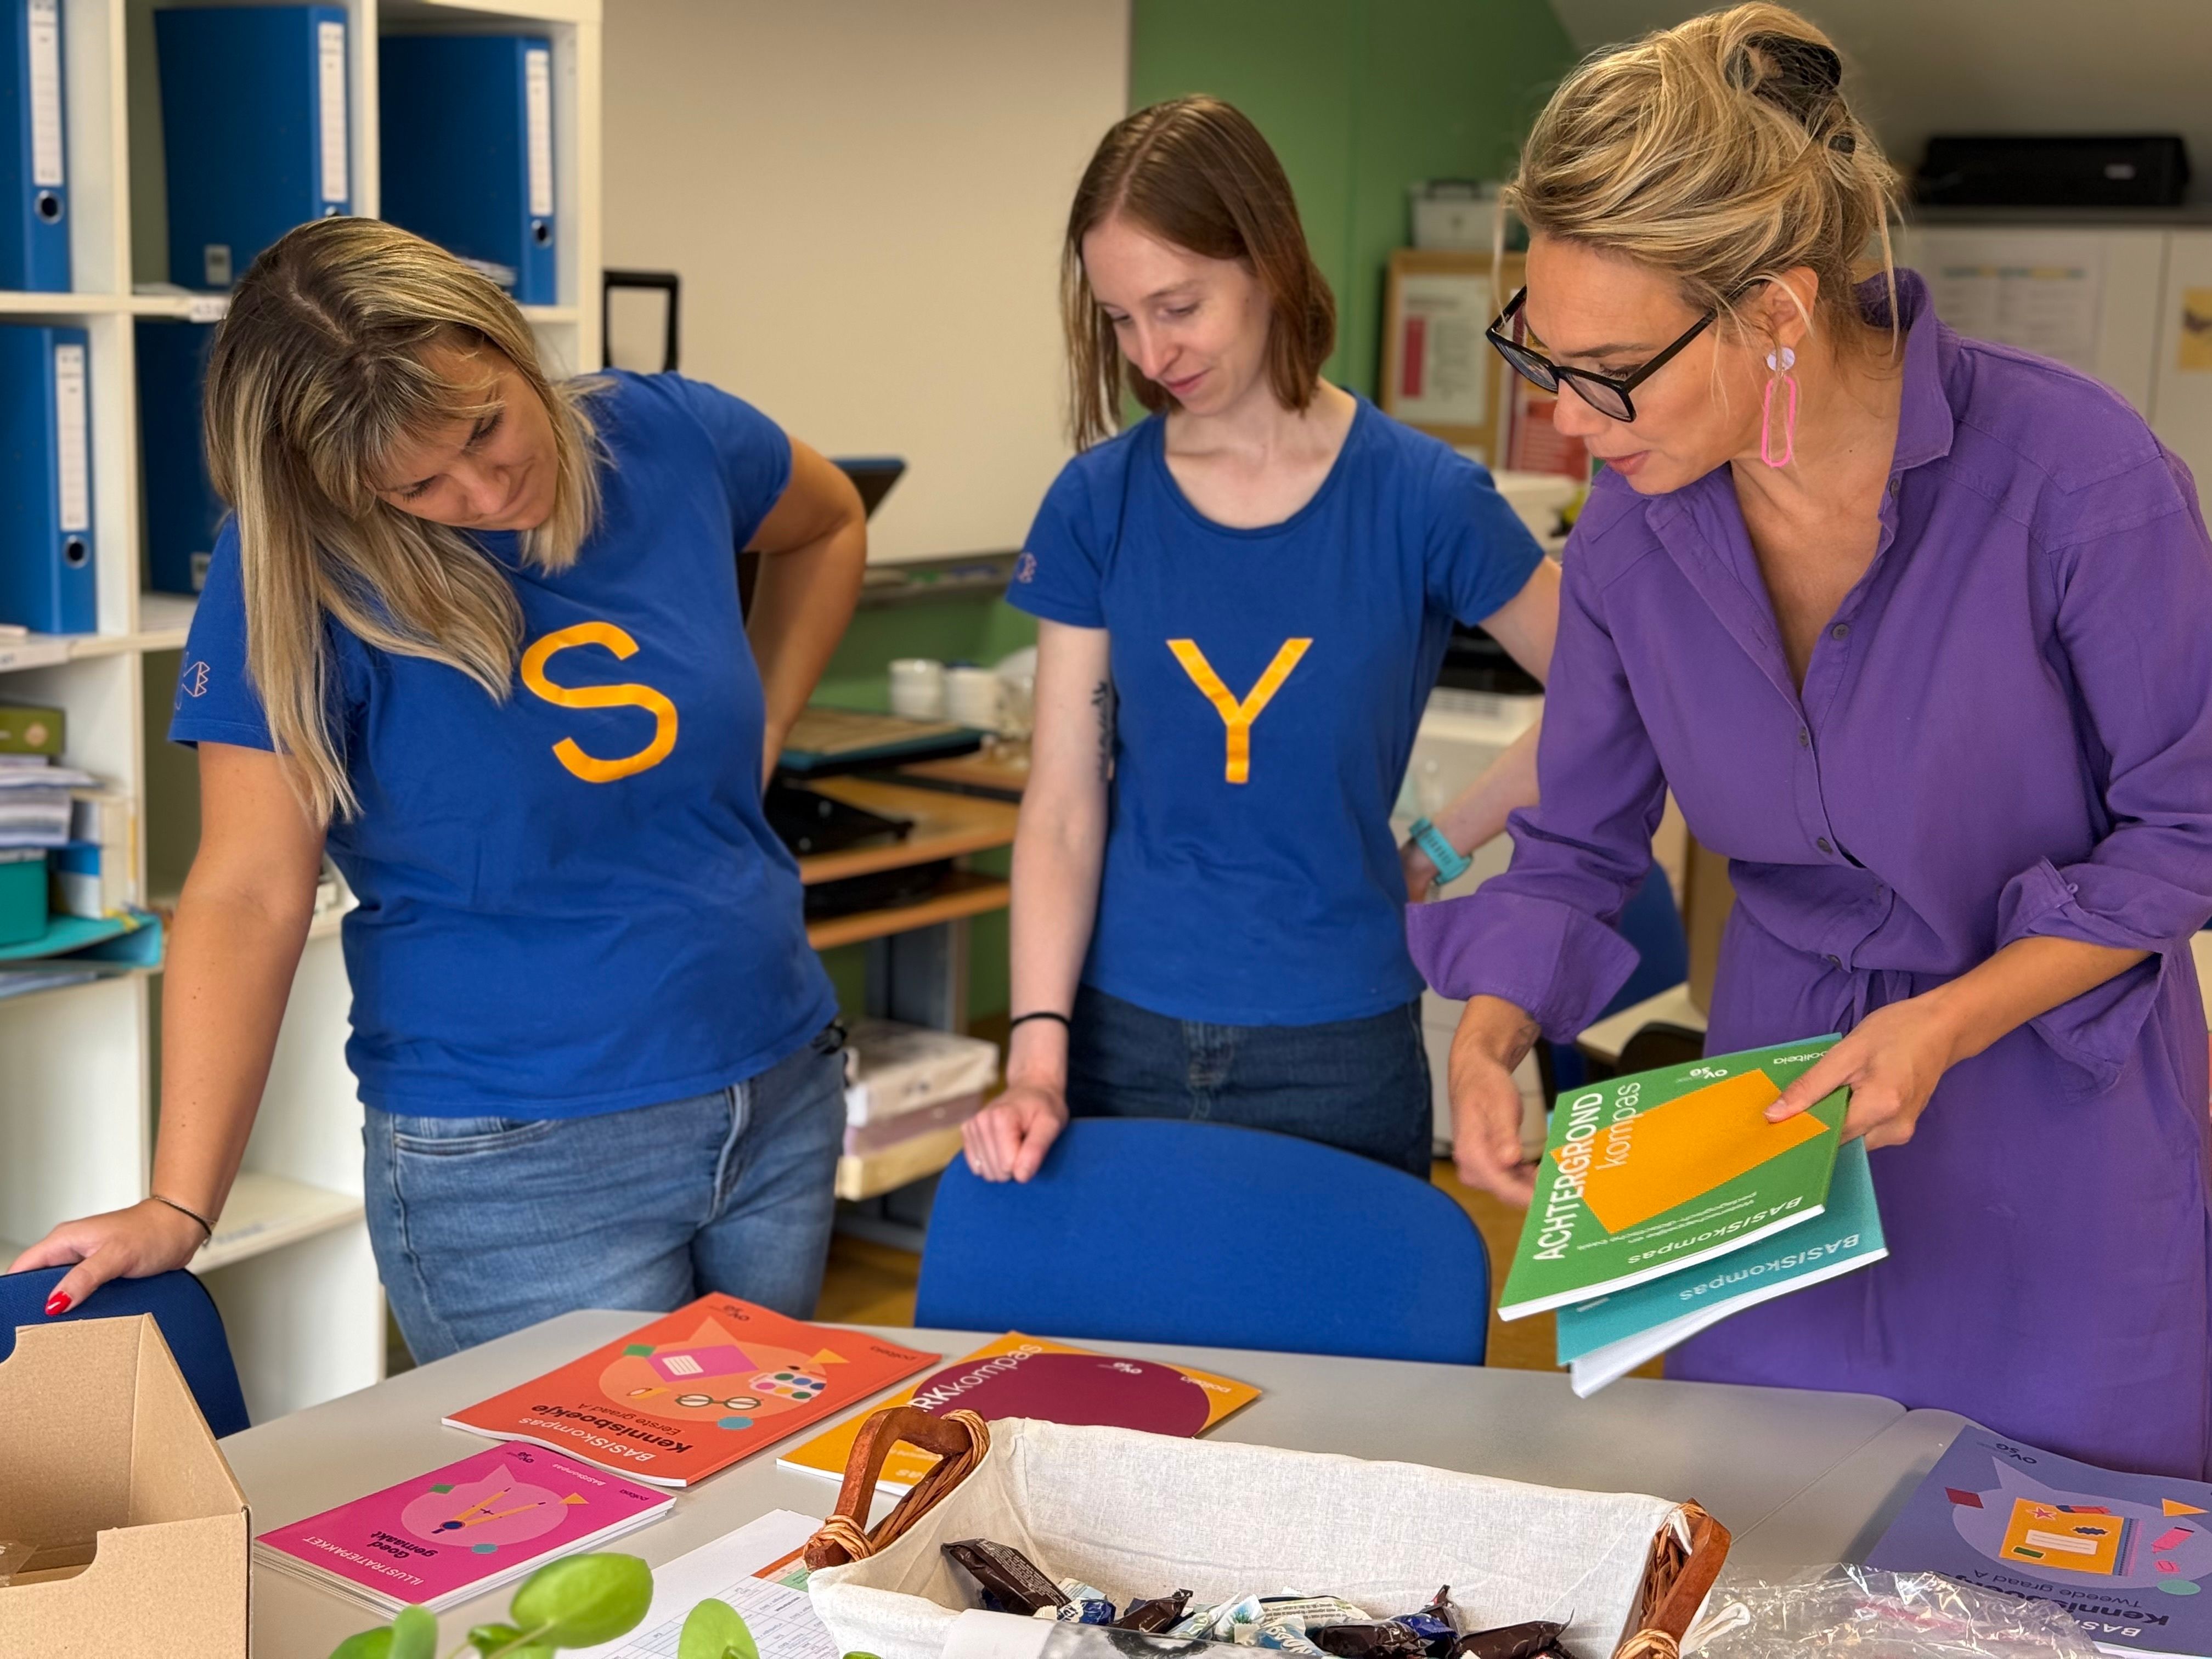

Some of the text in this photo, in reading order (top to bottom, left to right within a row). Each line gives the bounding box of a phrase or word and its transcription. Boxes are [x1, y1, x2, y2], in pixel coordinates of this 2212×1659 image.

[521, 621, 678, 783] S
[1166, 637, 1313, 783] Y
[1595, 1082, 1644, 1170] kompas
[1533, 1093, 1603, 1260] ACHTERGROND
[1628, 1195, 1804, 1264] BASISkompas
[1679, 1234, 1860, 1301] BASISkompas
[906, 1344, 1042, 1413] RKkompas
[531, 1404, 693, 1454] Kennisboekje
[591, 1405, 636, 1420] graad
[635, 1418, 681, 1436] Eerste
[518, 1417, 657, 1462] BASISkompas
[302, 1536, 424, 1585] ILLUSTRATIEPAKKET
[366, 1541, 410, 1559] Goed
[370, 1531, 438, 1557] gemaakt
[1974, 1569, 2142, 1607] Tweede graad A
